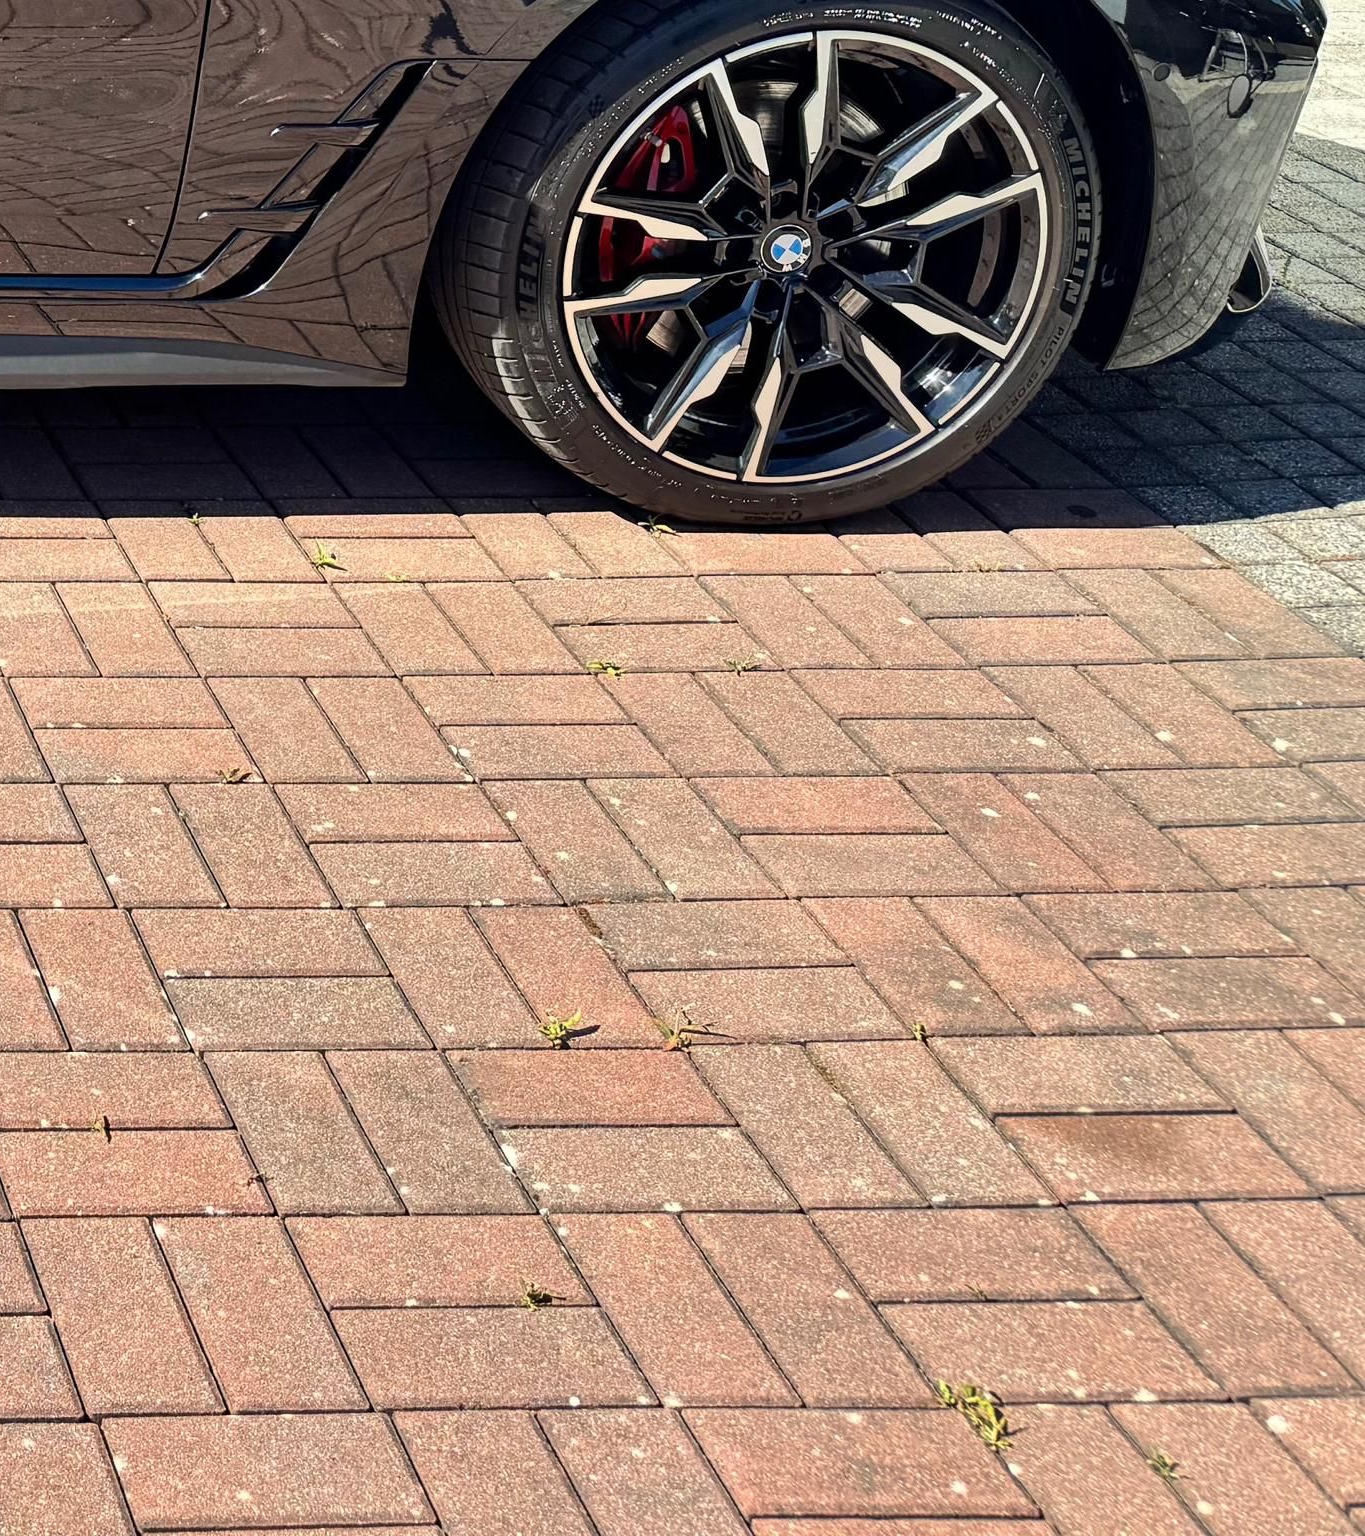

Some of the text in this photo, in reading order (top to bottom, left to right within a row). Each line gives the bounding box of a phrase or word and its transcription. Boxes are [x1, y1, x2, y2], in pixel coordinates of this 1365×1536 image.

[1060, 134, 1091, 305] MICHELIN
[1039, 326, 1065, 366] PILOT
[1004, 371, 1039, 412] SPORT
